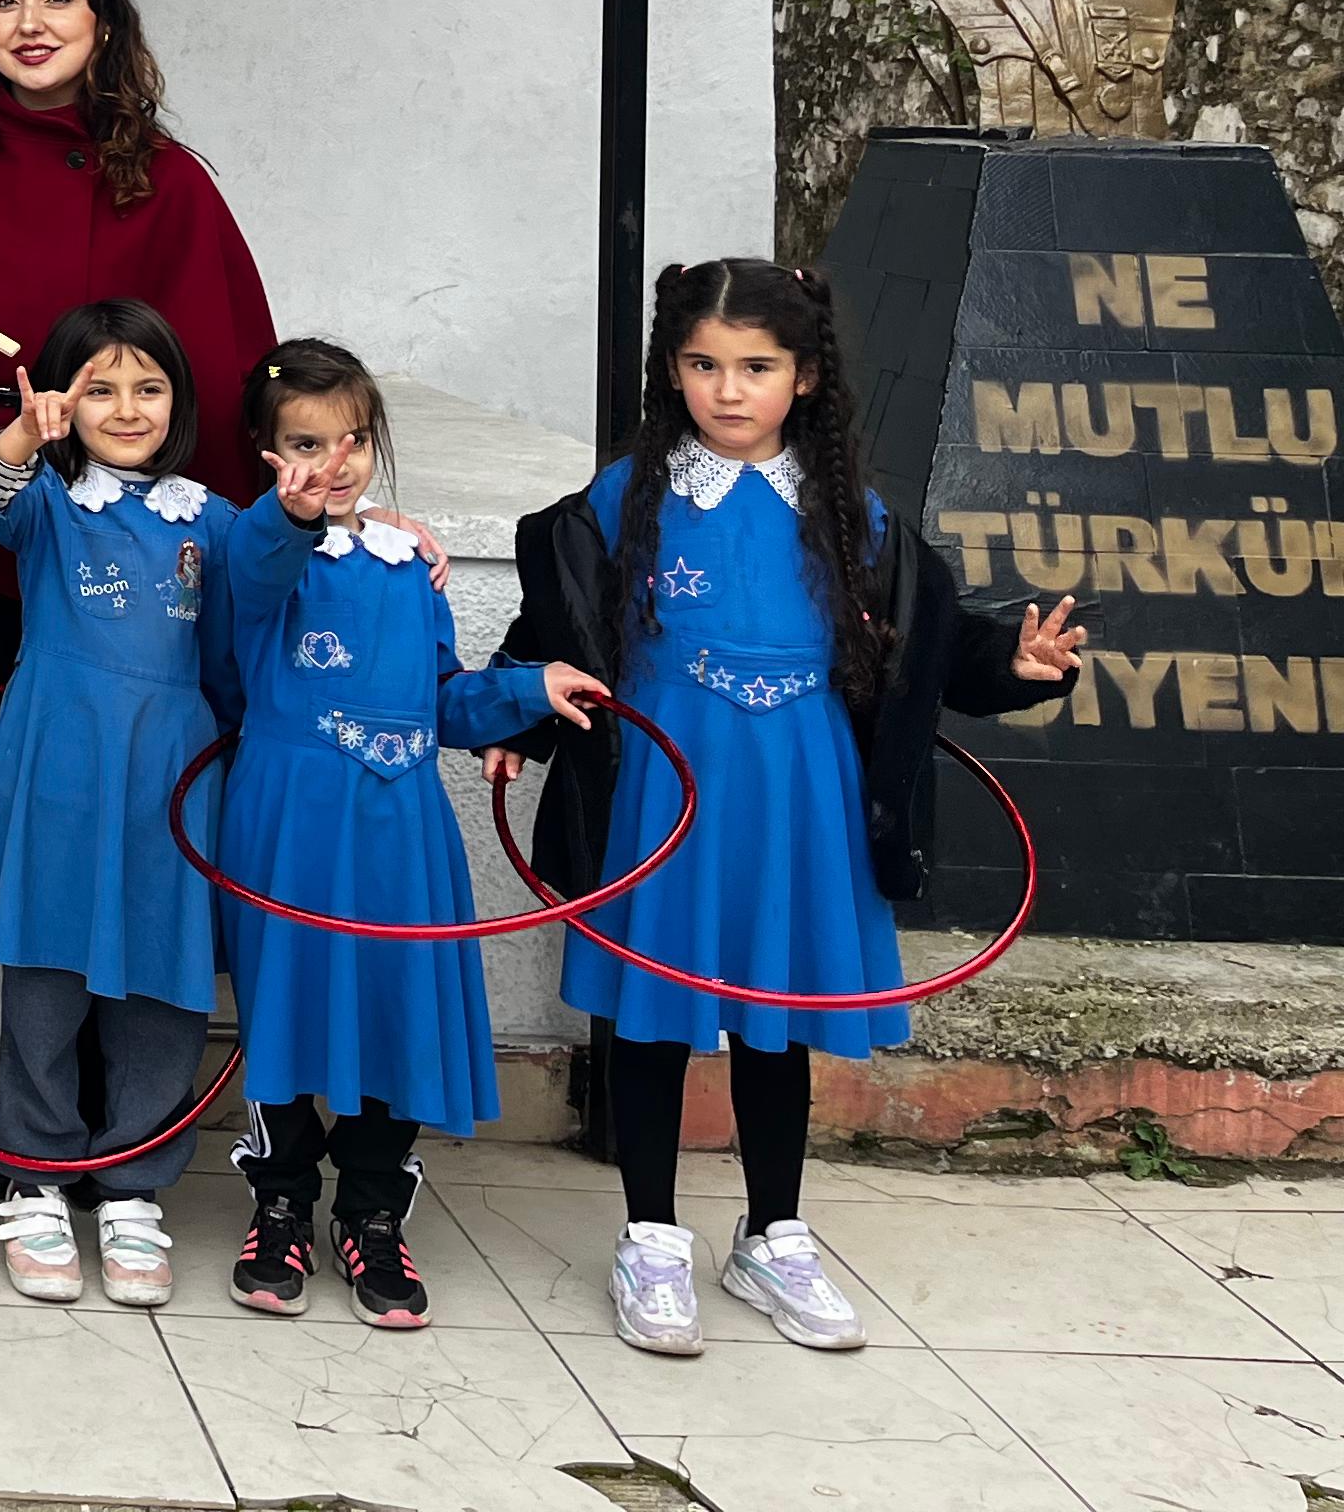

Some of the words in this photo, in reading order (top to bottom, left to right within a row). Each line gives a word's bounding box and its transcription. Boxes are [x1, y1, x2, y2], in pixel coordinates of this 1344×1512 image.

[1067, 253, 1217, 329] NE
[971, 381, 1339, 466] MUTLU
[79, 579, 130, 598] bloom
